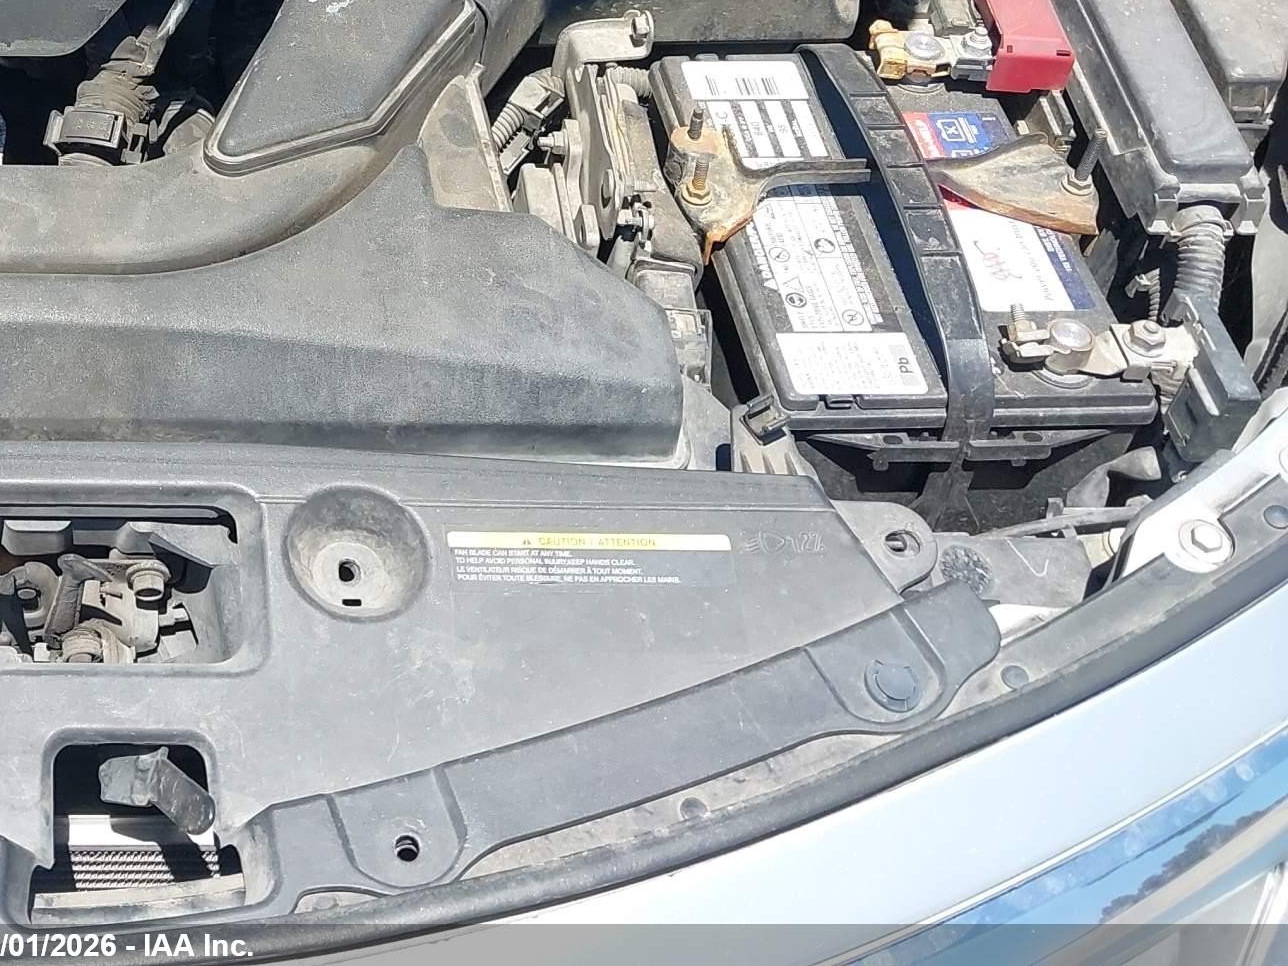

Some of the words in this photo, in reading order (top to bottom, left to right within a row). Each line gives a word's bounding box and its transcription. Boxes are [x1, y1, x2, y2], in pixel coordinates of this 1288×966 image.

[897, 356, 913, 374] Pb
[538, 537, 585, 546] CAUTION
[598, 538, 656, 547] ATTENTION
[549, 565, 585, 574] DÉMARRER
[478, 573, 502, 581] ÉVITER
